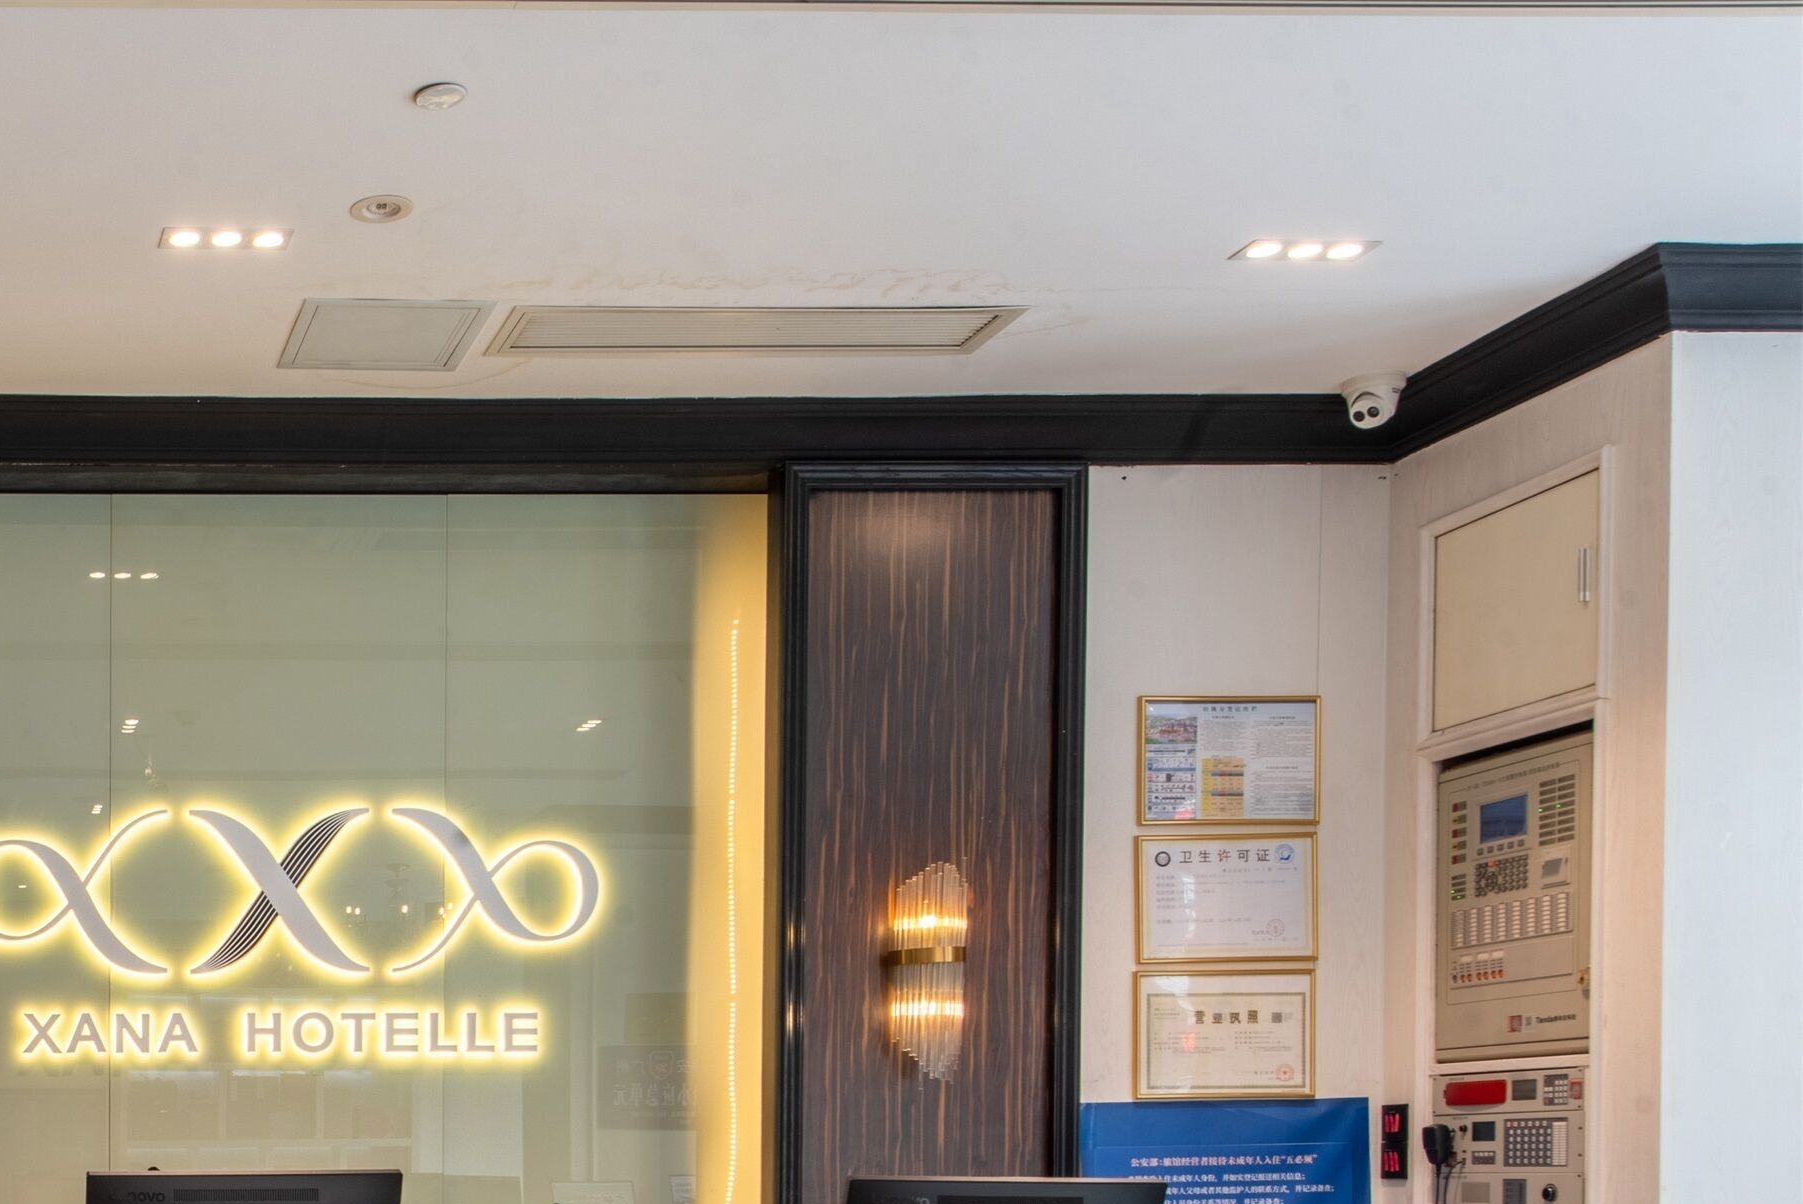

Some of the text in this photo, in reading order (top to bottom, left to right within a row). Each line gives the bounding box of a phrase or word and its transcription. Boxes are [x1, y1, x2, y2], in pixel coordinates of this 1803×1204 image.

[1179, 848, 1270, 864] 卫生许可证
[1194, 1010, 1259, 1025] 营业执照
[22, 1010, 540, 1054] XANA HOTELLE
